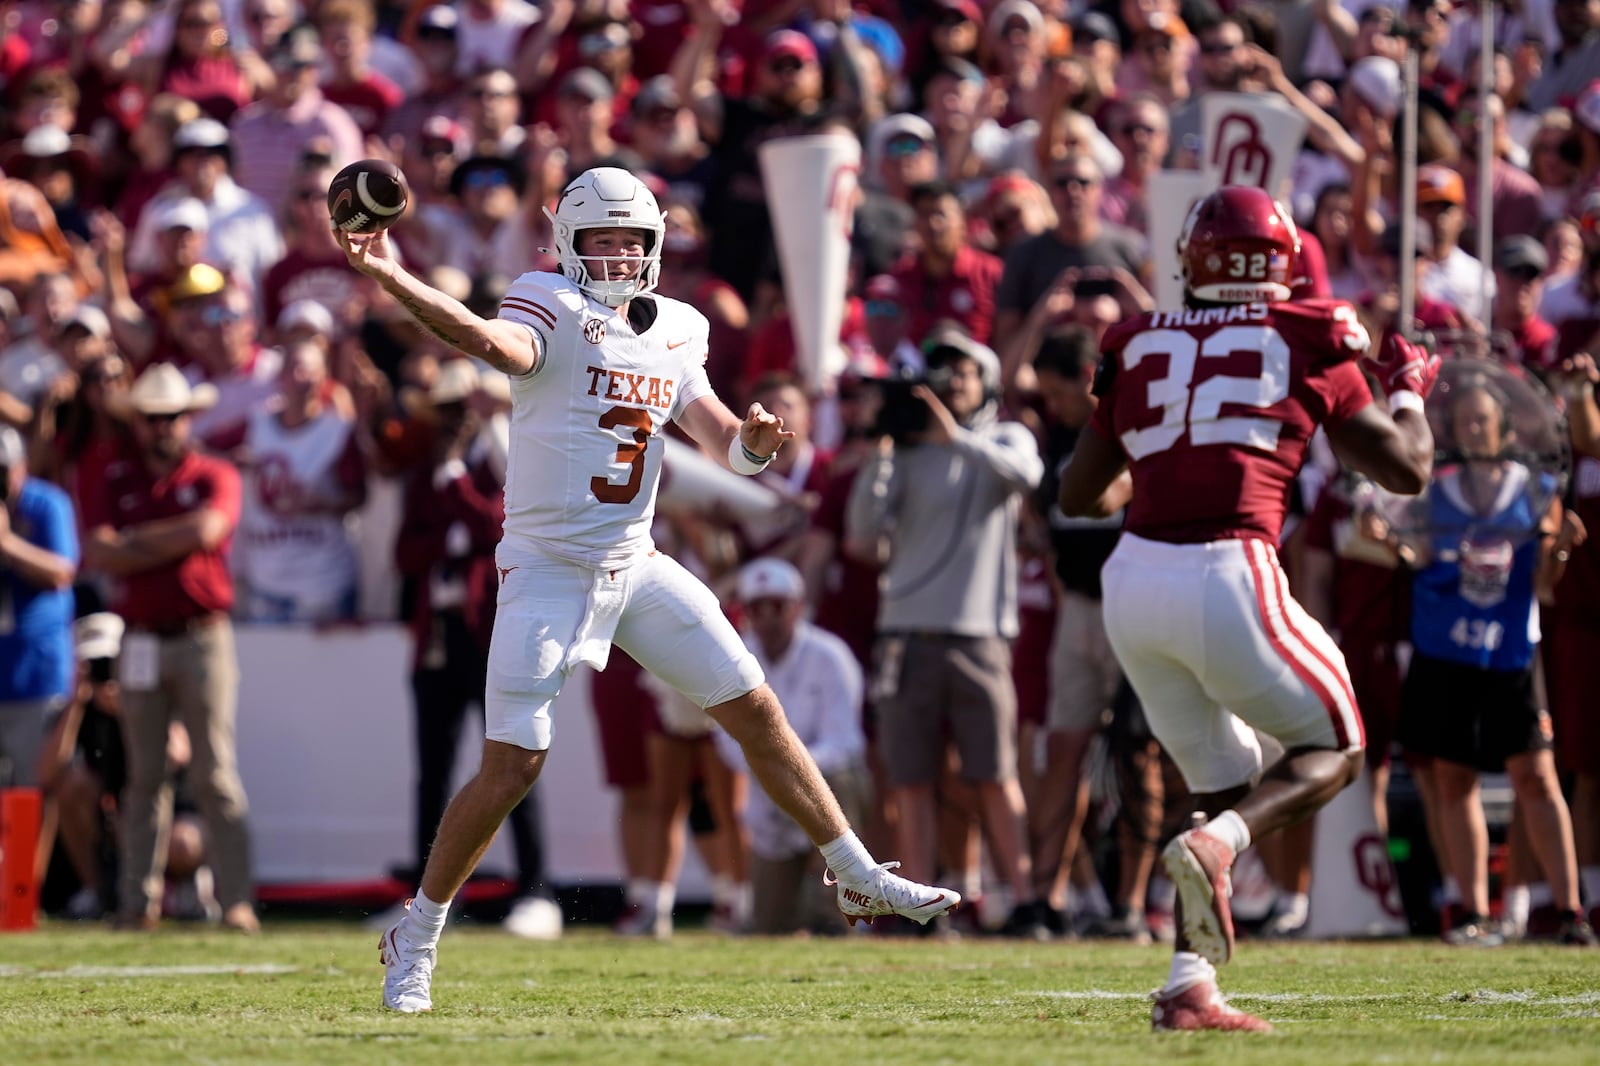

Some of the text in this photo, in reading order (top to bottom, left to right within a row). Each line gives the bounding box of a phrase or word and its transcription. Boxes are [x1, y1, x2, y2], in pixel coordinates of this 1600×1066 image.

[1229, 253, 1266, 278] 32
[1150, 302, 1268, 328] THOMAS
[584, 319, 606, 344] SEC
[586, 366, 673, 408] TEXAS
[1120, 326, 1290, 462] 32
[590, 405, 652, 504] 3
[843, 888, 872, 908] NIKE
